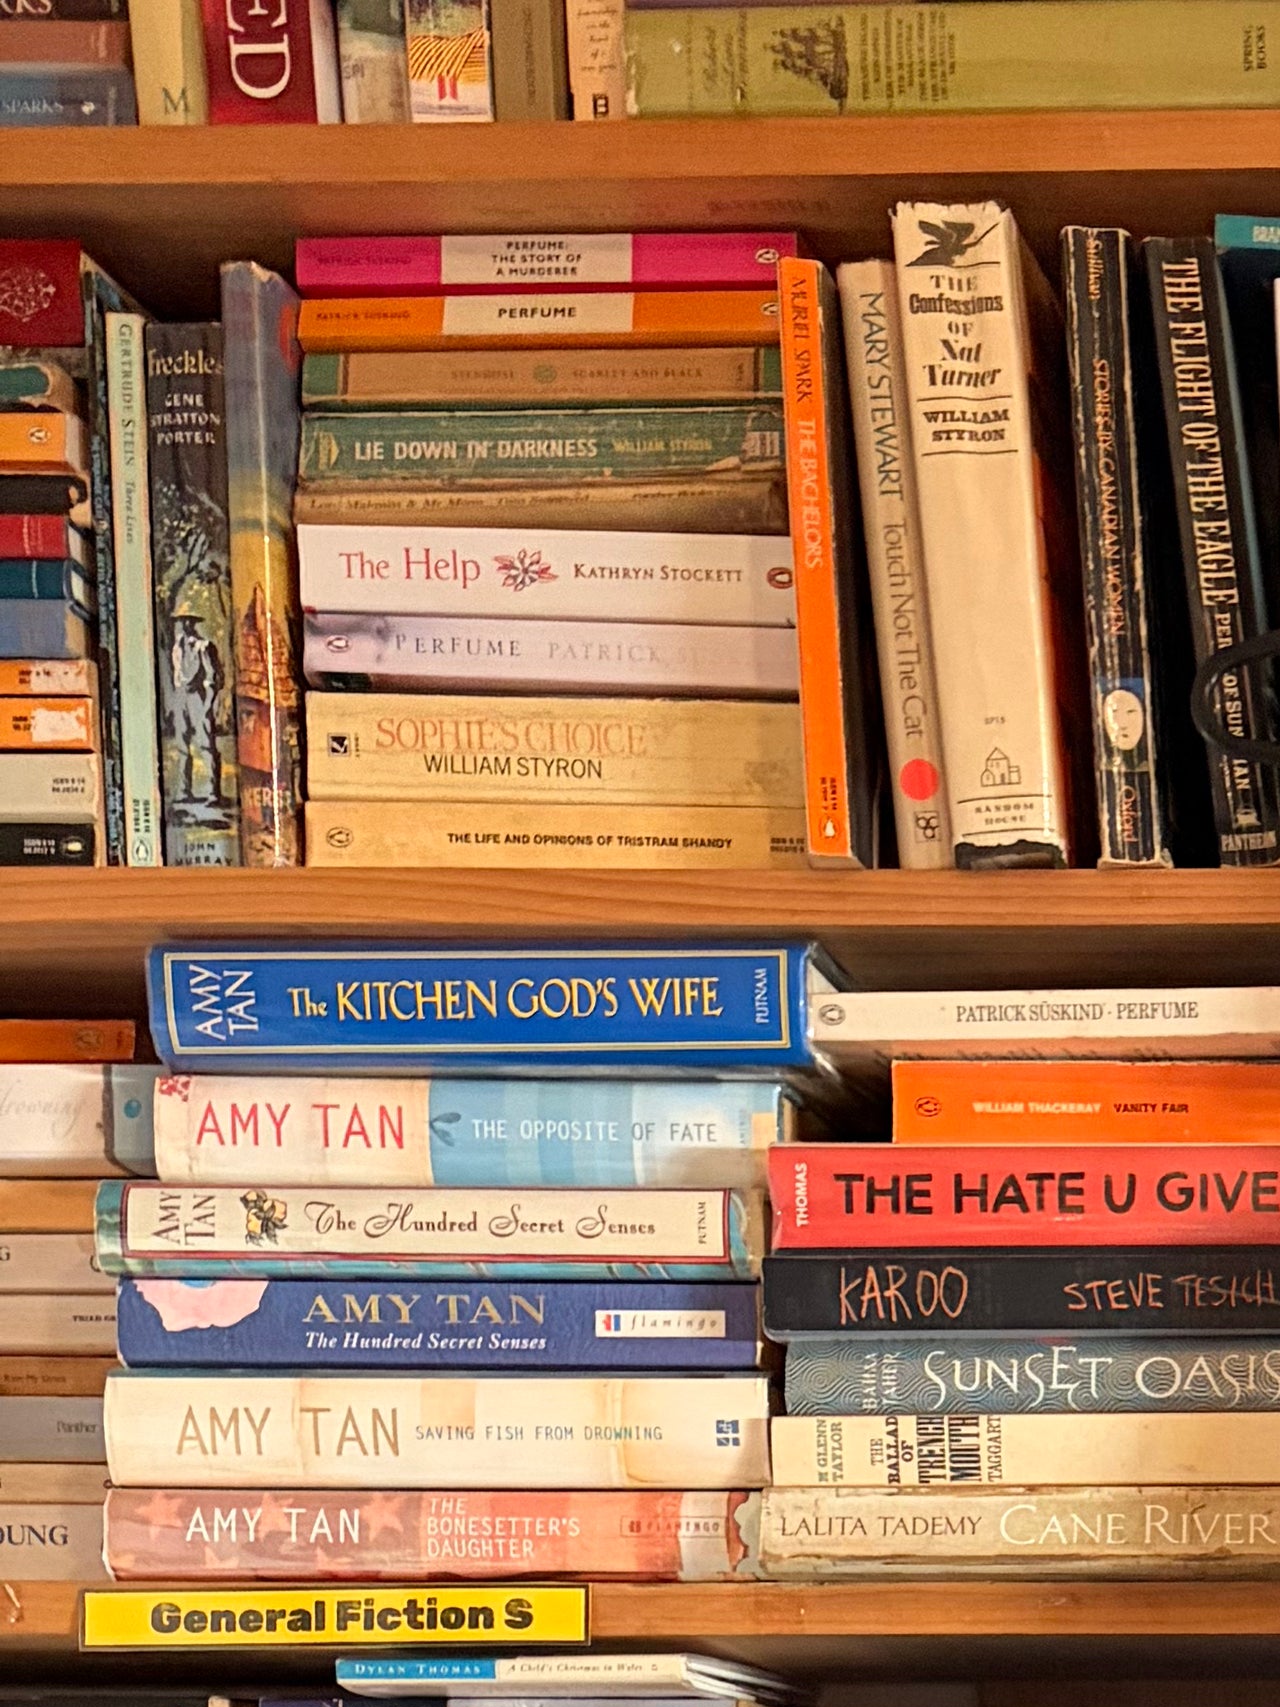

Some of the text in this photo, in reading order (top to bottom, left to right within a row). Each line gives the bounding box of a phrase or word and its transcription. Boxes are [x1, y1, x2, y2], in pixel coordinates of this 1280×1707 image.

[497, 306, 577, 320] PERFUME
[861, 293, 903, 501] MARY STEWART
[354, 437, 598, 461] LIE DOWN IN DARKNESS
[340, 548, 743, 589] The Help KATHRYN STOCKETT
[336, 982, 498, 1023] KITCHEN
[508, 977, 619, 1019] GOD'S
[630, 976, 723, 1017] WIFE
[1116, 1001, 1199, 1019] PERFUME
[197, 1104, 404, 1149] AMY TAN
[471, 1119, 717, 1142] THE OPPOSITE OF FATE
[834, 1171, 1280, 1216] THE HATE U GIVE
[839, 1266, 1164, 1325] KAROO STEVE
[177, 1407, 399, 1456] AMY TAN
[415, 1424, 662, 1442] SAVING FISH FROM DROWNING
[150, 1599, 534, 1634] General Fiction S
